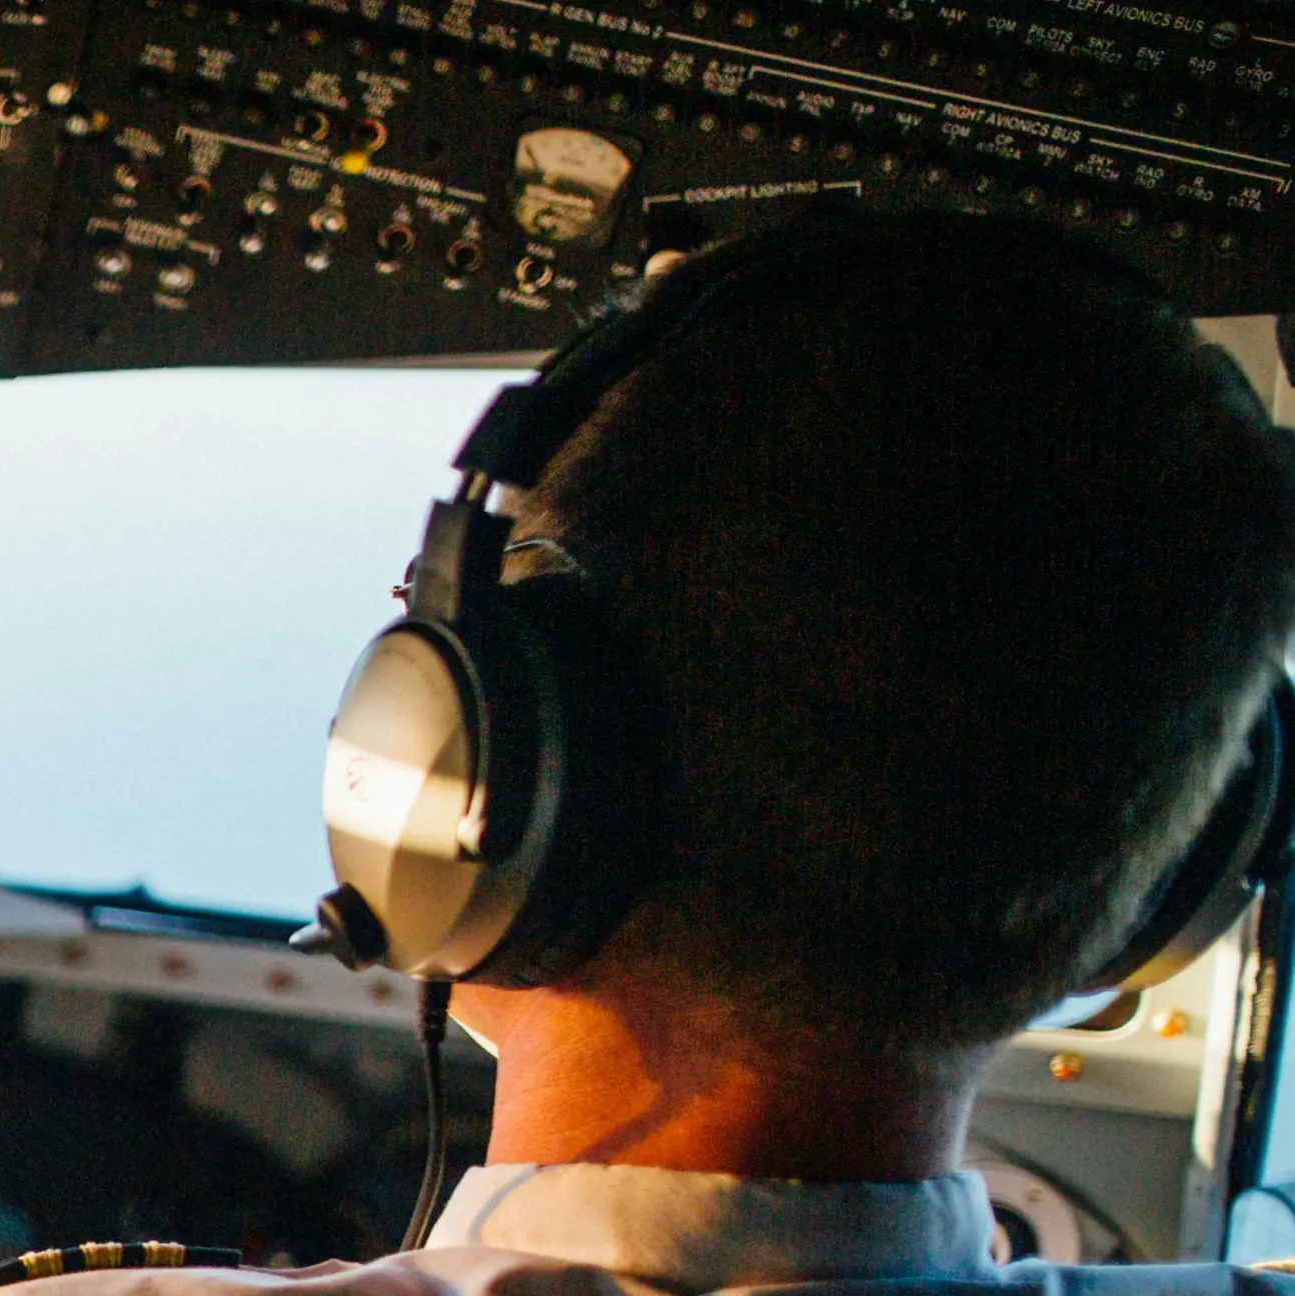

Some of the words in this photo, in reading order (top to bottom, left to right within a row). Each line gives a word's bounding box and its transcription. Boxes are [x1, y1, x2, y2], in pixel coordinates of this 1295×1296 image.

[563, 5, 595, 24] GEN
[597, 11, 628, 31] BUS
[938, 7, 967, 22] NAV
[987, 16, 1017, 32] COM
[1104, 4, 1173, 27] AVIONICS
[1174, 16, 1205, 33] BUS
[1028, 24, 1074, 43] PILOTS
[1088, 36, 1115, 50] SKY
[1235, 65, 1273, 82] GYRO
[941, 102, 986, 122] RIGHT
[985, 112, 1050, 137] AVIONICS
[1051, 125, 1082, 144] BUS
[941, 122, 972, 138] COM
[361, 163, 442, 194] ROTECTION
[684, 184, 747, 204] COCKPIT
[749, 180, 818, 199] LIGHTING
